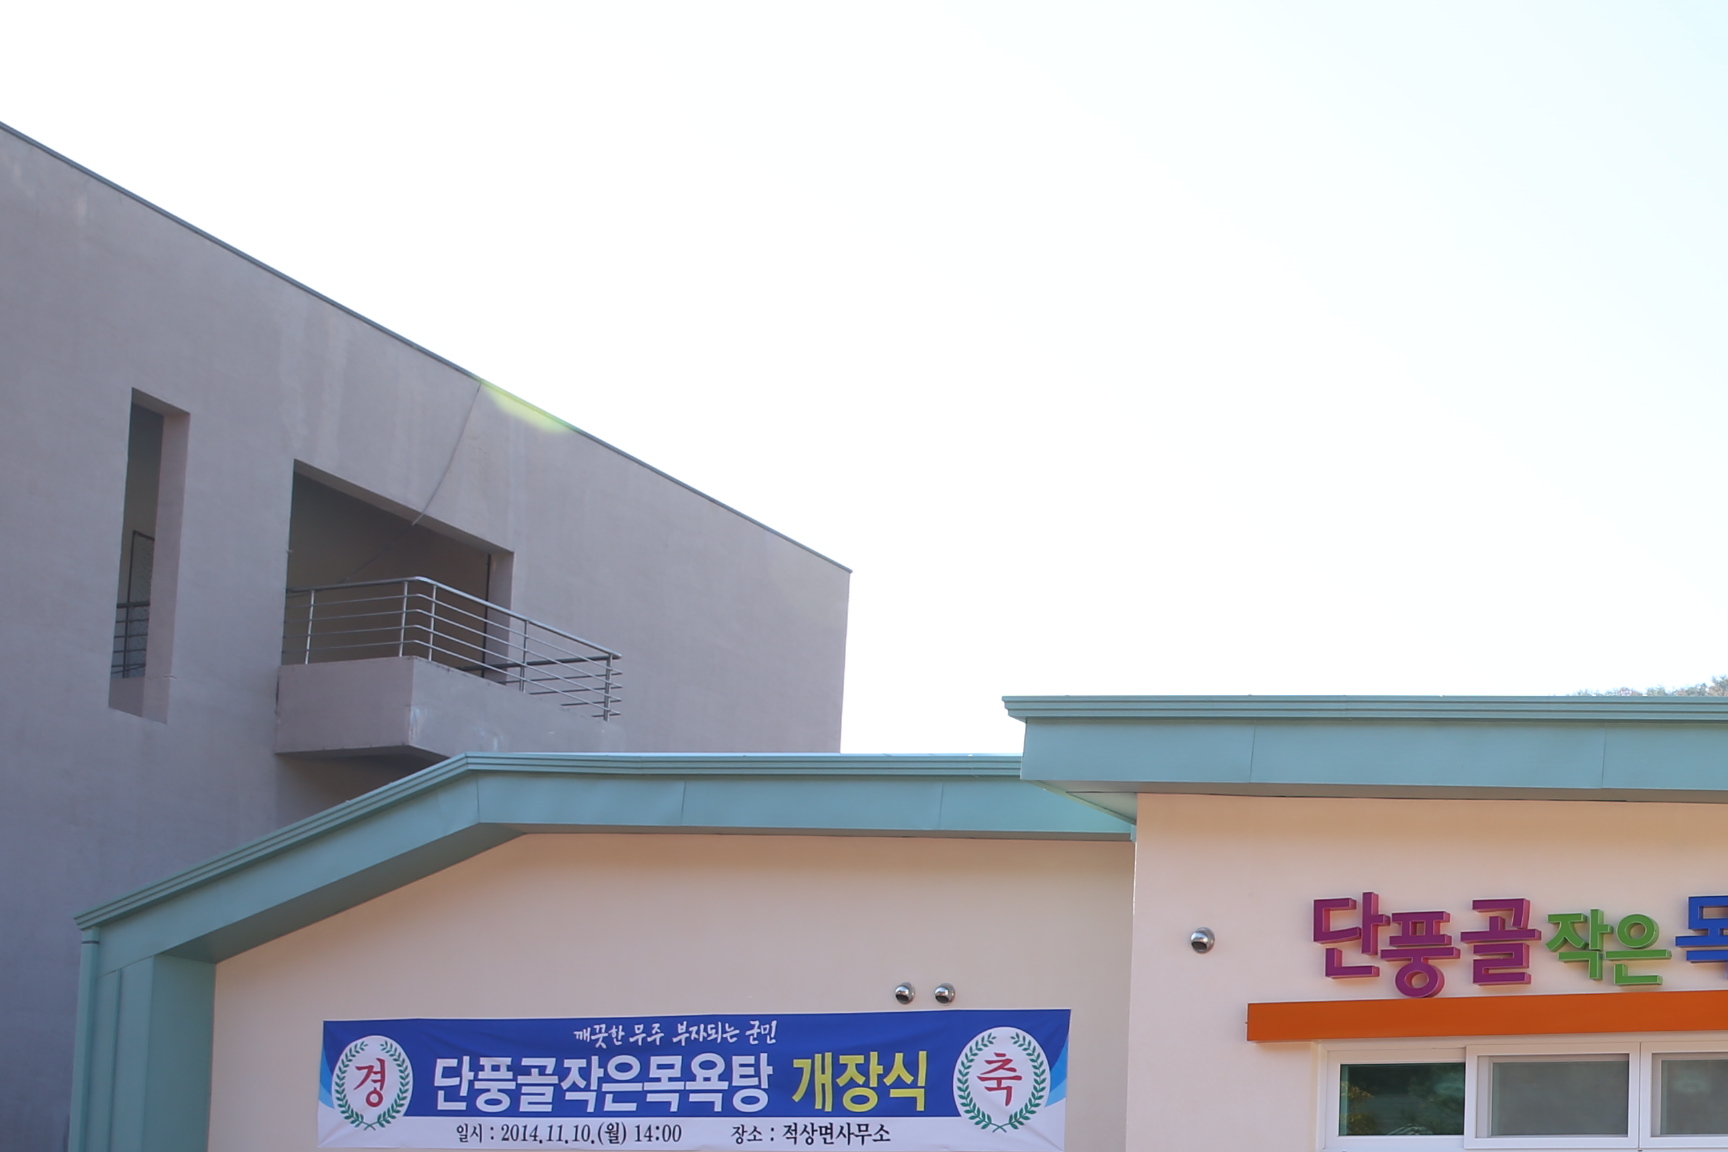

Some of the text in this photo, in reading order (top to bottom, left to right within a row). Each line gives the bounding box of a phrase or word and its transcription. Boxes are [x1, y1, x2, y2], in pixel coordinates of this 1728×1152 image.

[1313, 891, 1541, 998] 단풍골
[1546, 909, 1672, 985] 작은
[573, 1020, 778, 1049] 깨끗한 무주 부자되는 군민
[354, 1057, 386, 1108] 경
[433, 1050, 928, 1114] 단풍골작은목욕탕 개장식
[977, 1052, 1023, 1107] 축
[634, 1123, 682, 1143] 14:00
[783, 1122, 891, 1146] 적상면사무소
